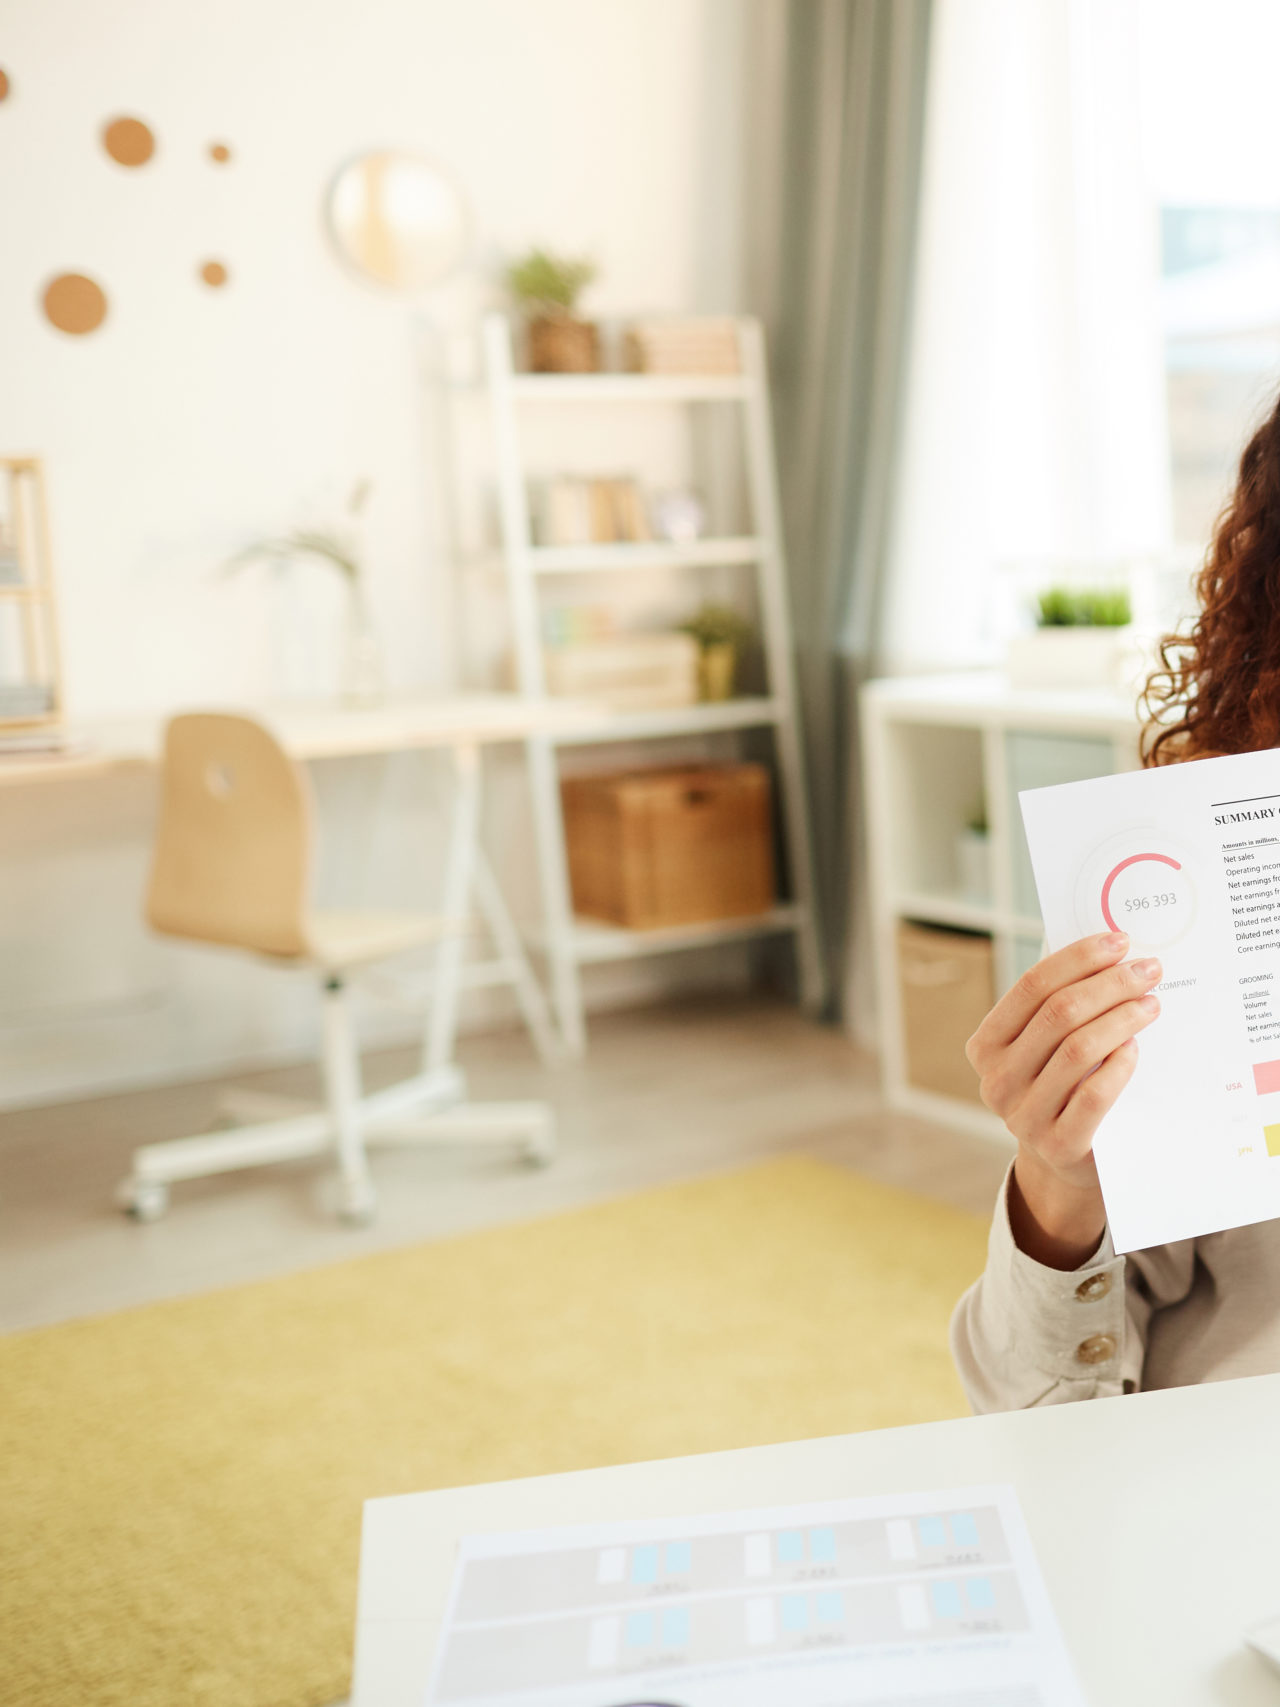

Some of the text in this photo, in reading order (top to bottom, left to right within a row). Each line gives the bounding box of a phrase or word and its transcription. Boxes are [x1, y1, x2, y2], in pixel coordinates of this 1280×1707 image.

[1214, 808, 1275, 826] SUMMARY
[1221, 841, 1248, 850] Amounts
[1255, 837, 1280, 845] millions,
[1223, 853, 1255, 864] Net sales
[1225, 866, 1261, 877] Operating
[1227, 881, 1241, 889] Net
[1242, 877, 1272, 888] earnings
[1230, 894, 1243, 902] Net
[1243, 890, 1274, 900] earnings
[1124, 892, 1177, 913] $96 393
[1231, 907, 1245, 915] Net
[1246, 903, 1276, 913] earnings
[1233, 917, 1260, 928] Diluted
[1260, 916, 1272, 924] net
[1235, 930, 1261, 941] Diluted
[1262, 929, 1274, 937] net
[1237, 946, 1254, 954] Core
[1157, 977, 1197, 992] COMPANY
[1238, 973, 1274, 985] GROOMING
[1243, 1001, 1268, 1010] Volume
[1257, 1011, 1273, 1019] sales
[1225, 1081, 1243, 1092] USA
